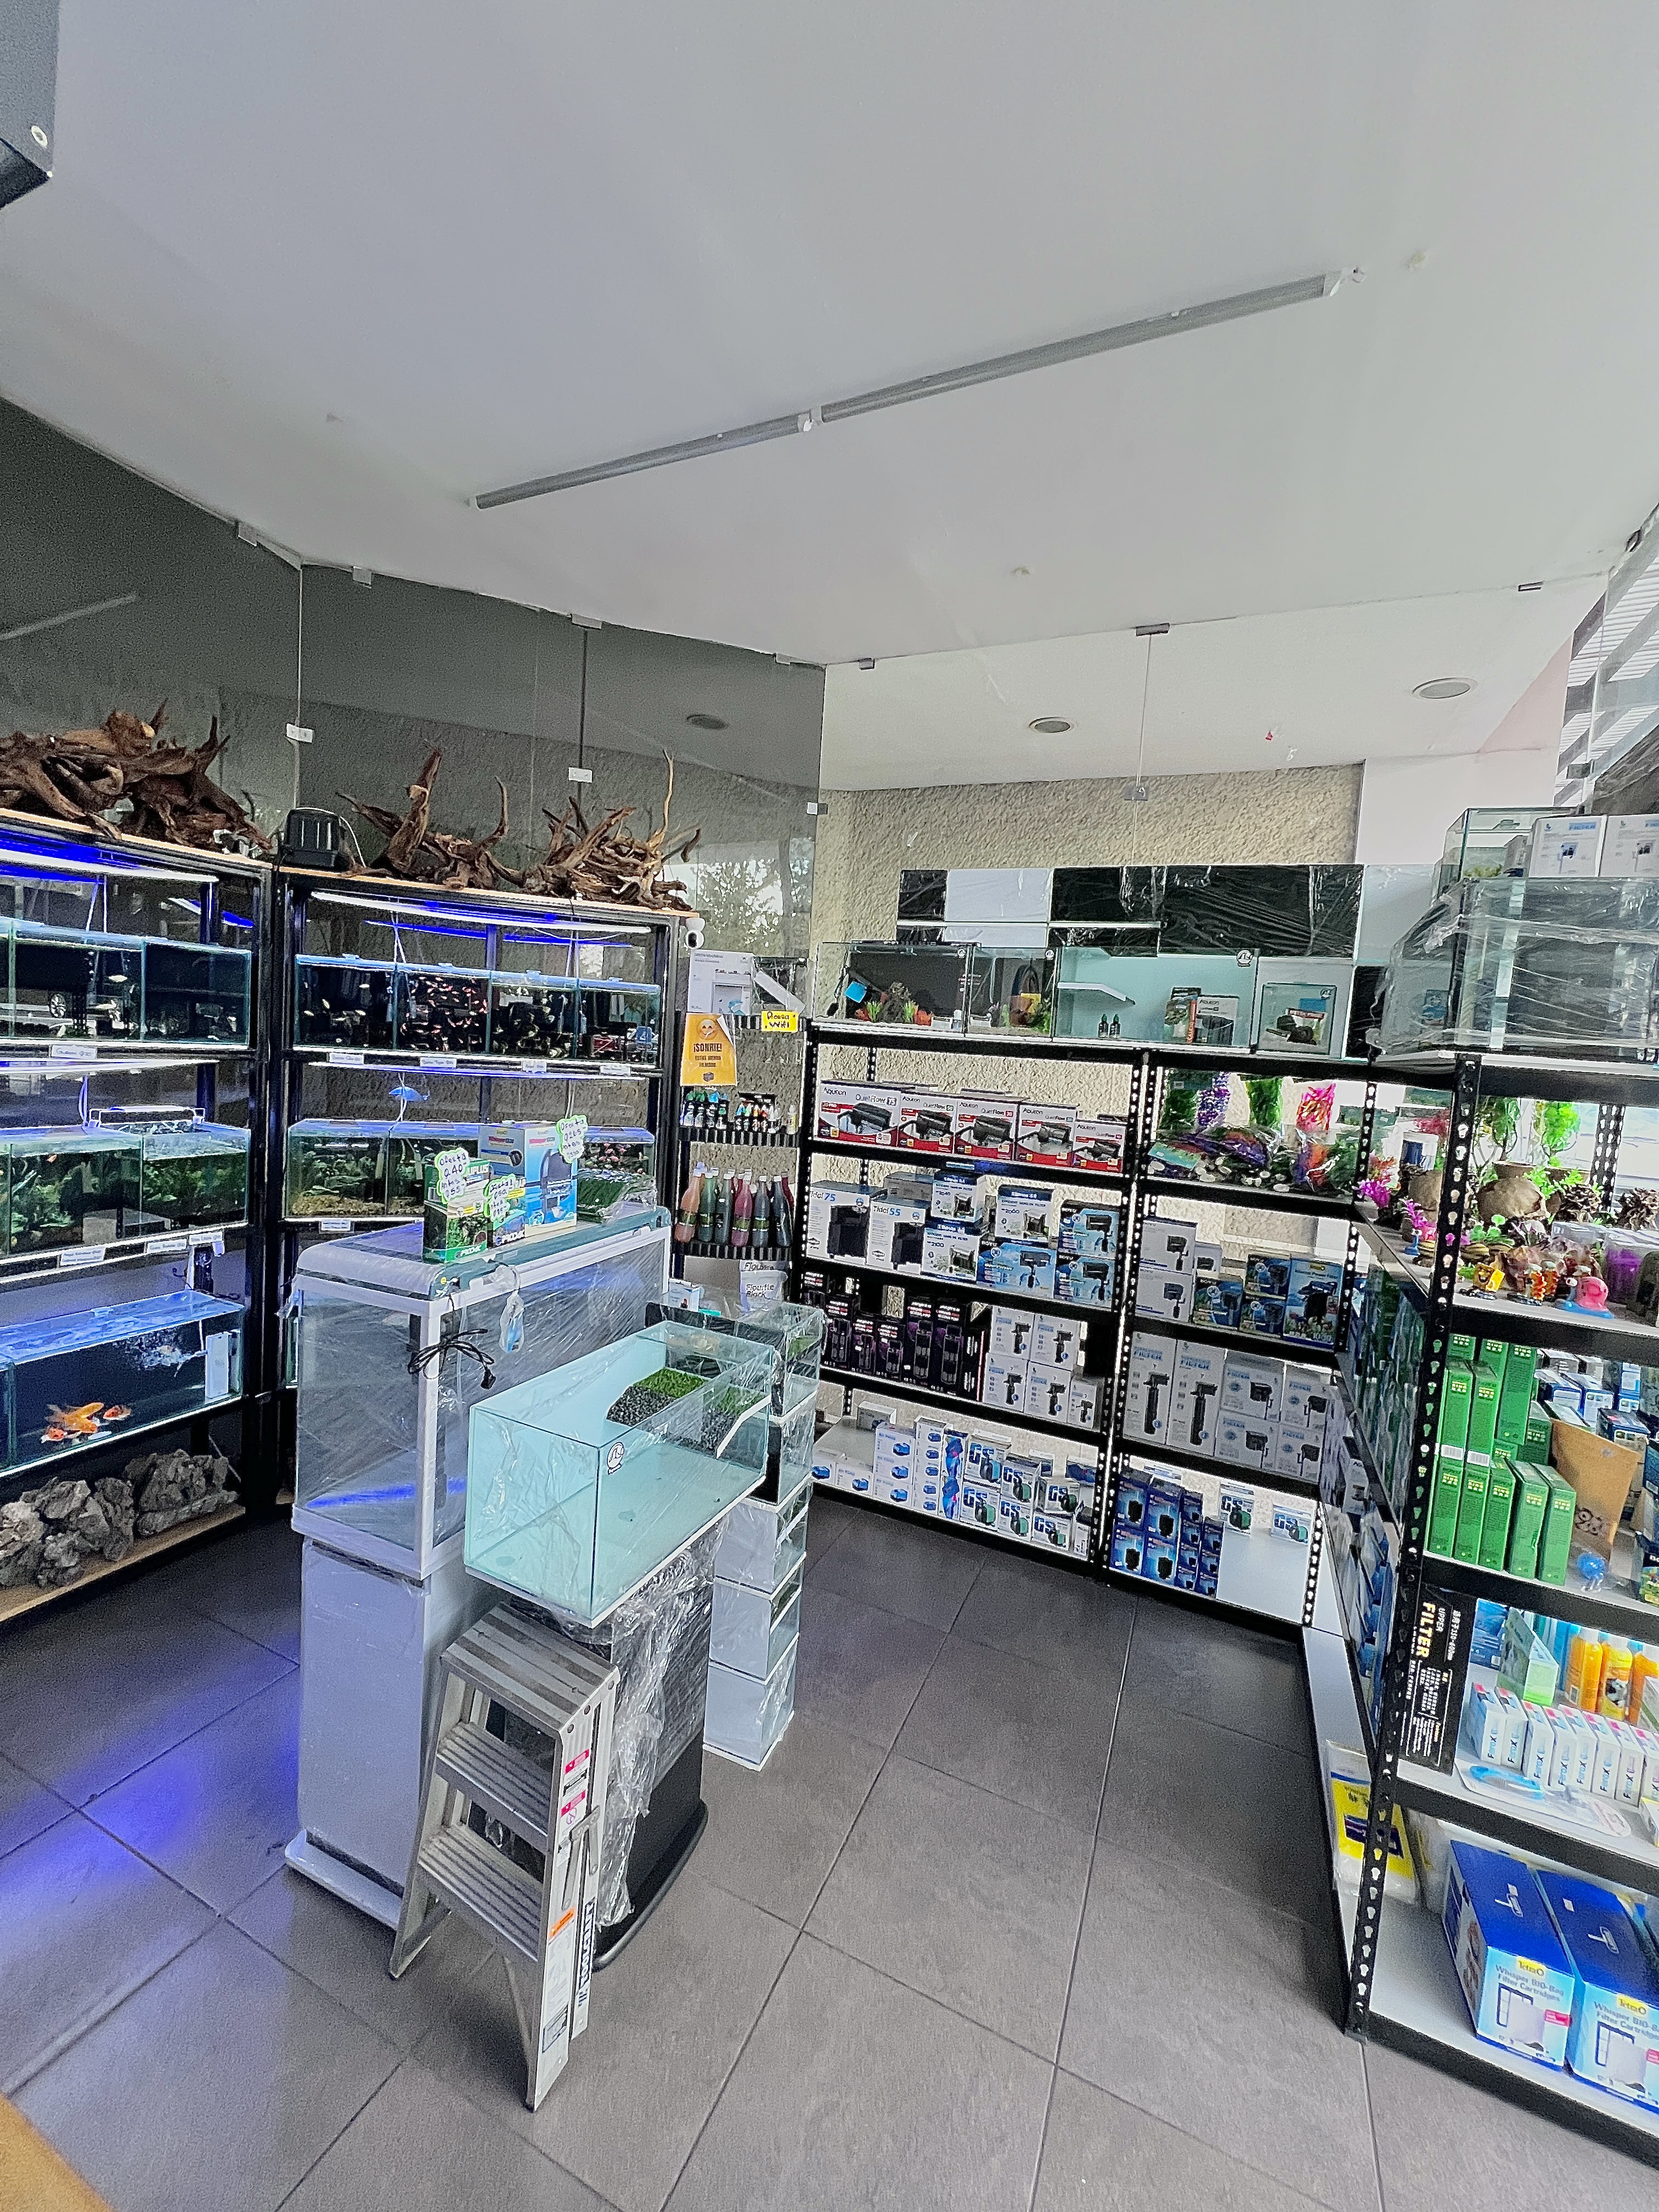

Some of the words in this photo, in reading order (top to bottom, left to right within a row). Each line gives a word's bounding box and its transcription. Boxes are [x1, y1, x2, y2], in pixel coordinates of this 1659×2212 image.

[822, 1087, 846, 1096] Aqueon
[439, 1153, 466, 1166] Oferta
[824, 1193, 836, 1201] 75
[873, 1205, 889, 1214] Tidal
[889, 1208, 901, 1216] 55
[1133, 1350, 1163, 1361] FILTER
[1436, 1607, 1446, 1632] UPPER
[1416, 1602, 1436, 1657] FILTER
[1496, 1964, 1528, 1983] Whisper
[1498, 1973, 1517, 1986] Filter
[1520, 1982, 1560, 2001] Cartridges
[1594, 2001, 1629, 2021] Whisper
[1633, 2016, 1659, 2033] BIO-B
[1596, 2011, 1618, 2024] Filter
[1620, 2021, 1659, 2040] Cartridge
